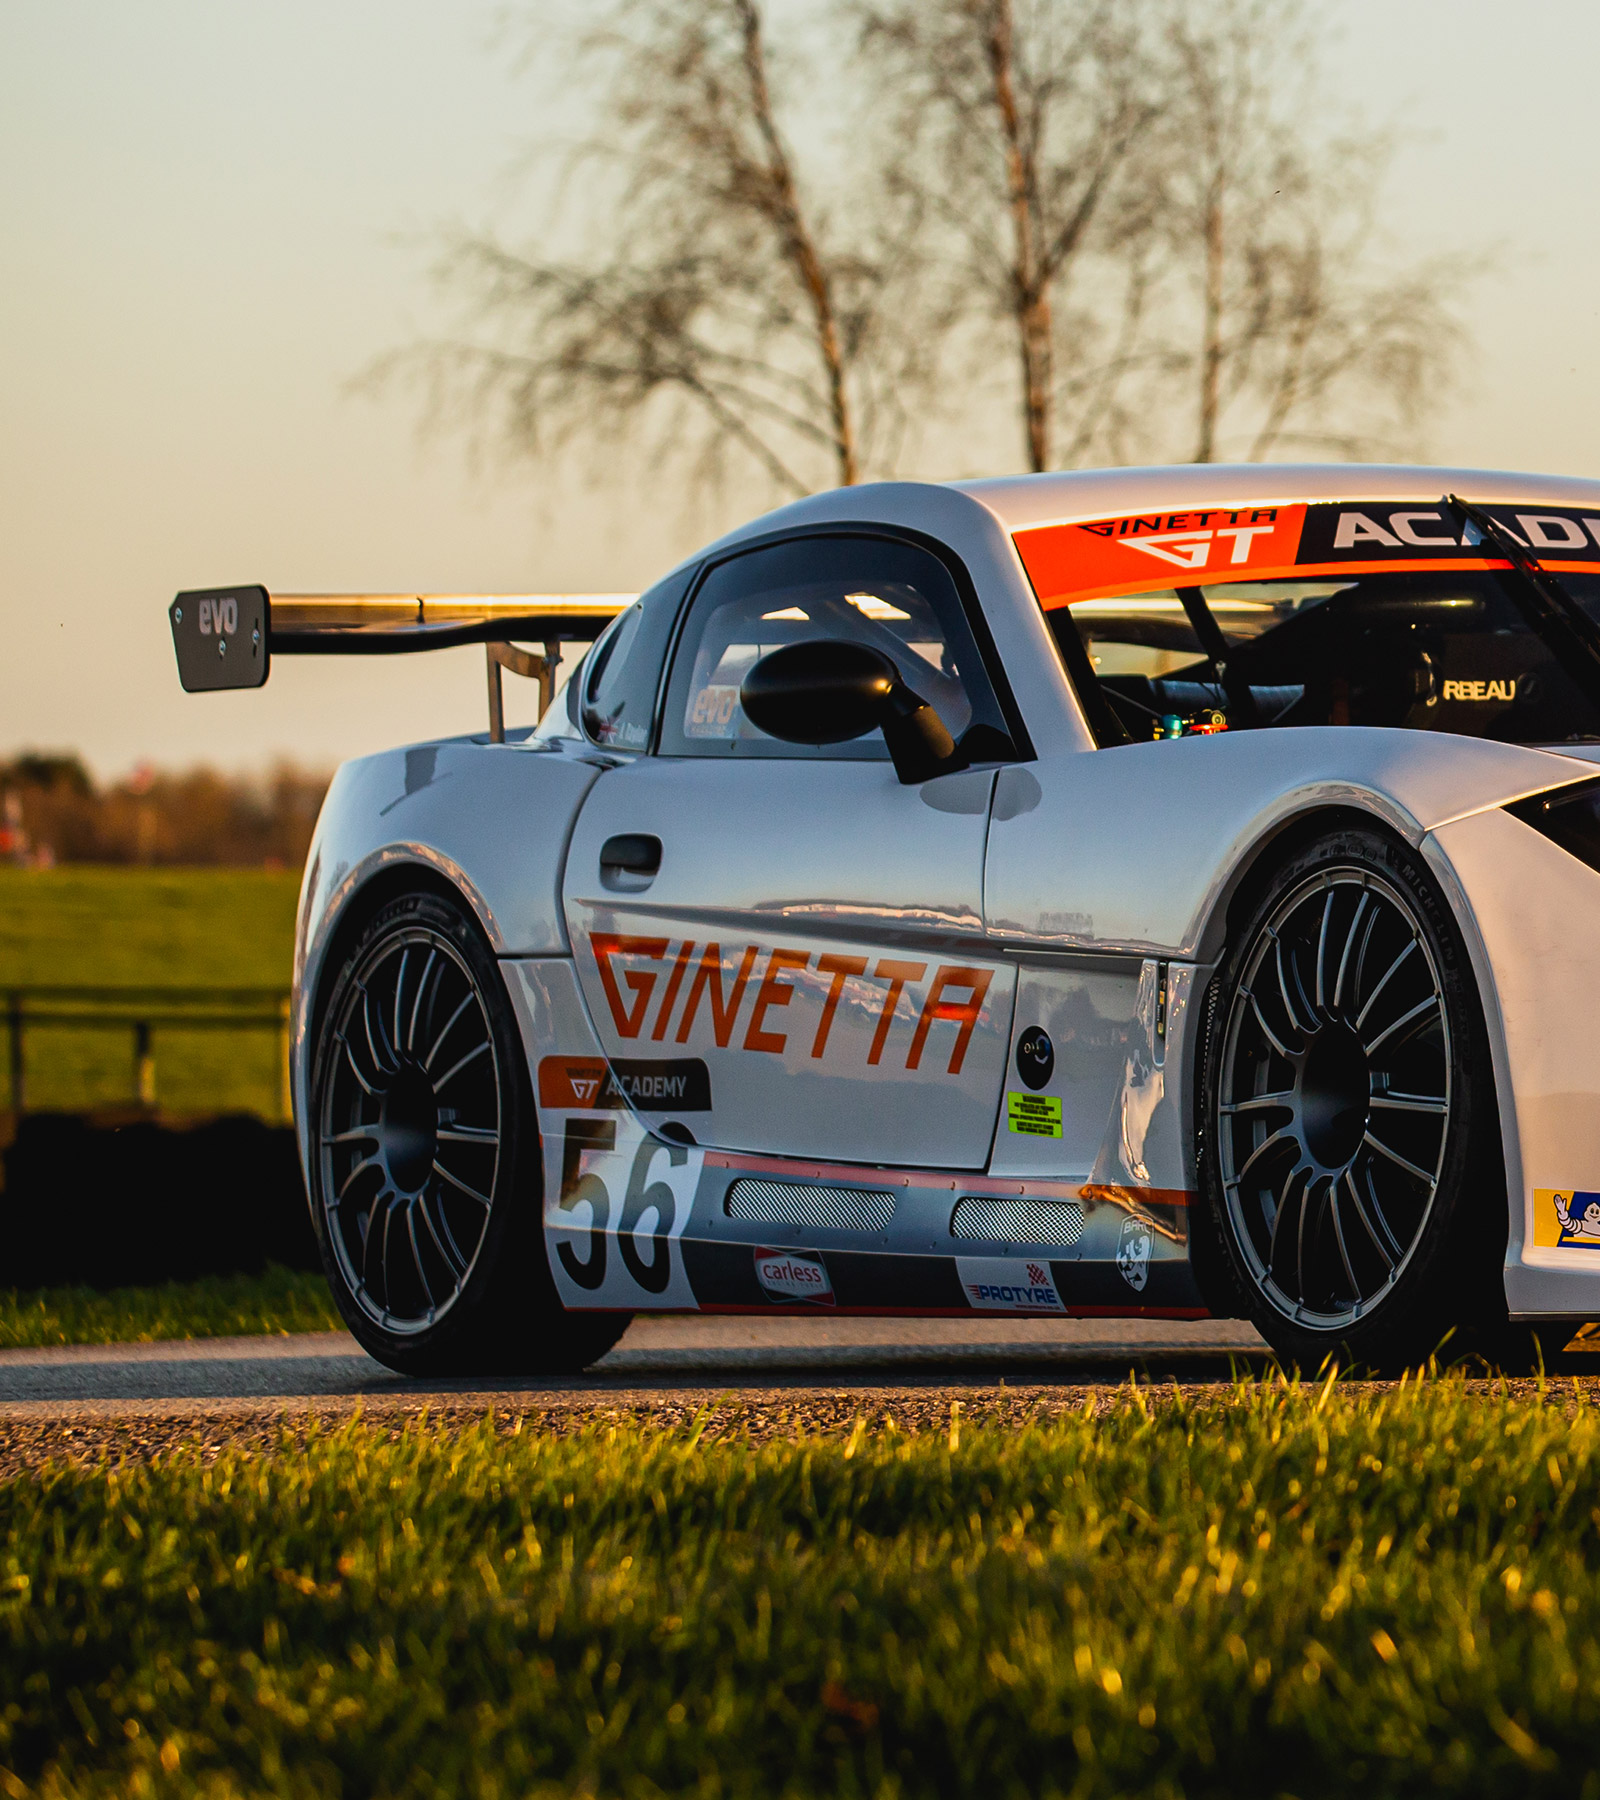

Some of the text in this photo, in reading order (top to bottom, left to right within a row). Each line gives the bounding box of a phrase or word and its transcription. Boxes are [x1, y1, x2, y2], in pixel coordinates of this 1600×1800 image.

[1076, 508, 1278, 536] GINETTA
[1116, 525, 1275, 568] GT
[198, 597, 238, 635] evo
[693, 688, 736, 724] evo
[589, 932, 996, 1074] GINETTA
[570, 1079, 599, 1099] GT
[606, 1076, 687, 1097] ACADEMY
[556, 1118, 689, 1293] 56
[763, 1260, 822, 1283] carless
[977, 1285, 1058, 1304] PROTYRE
